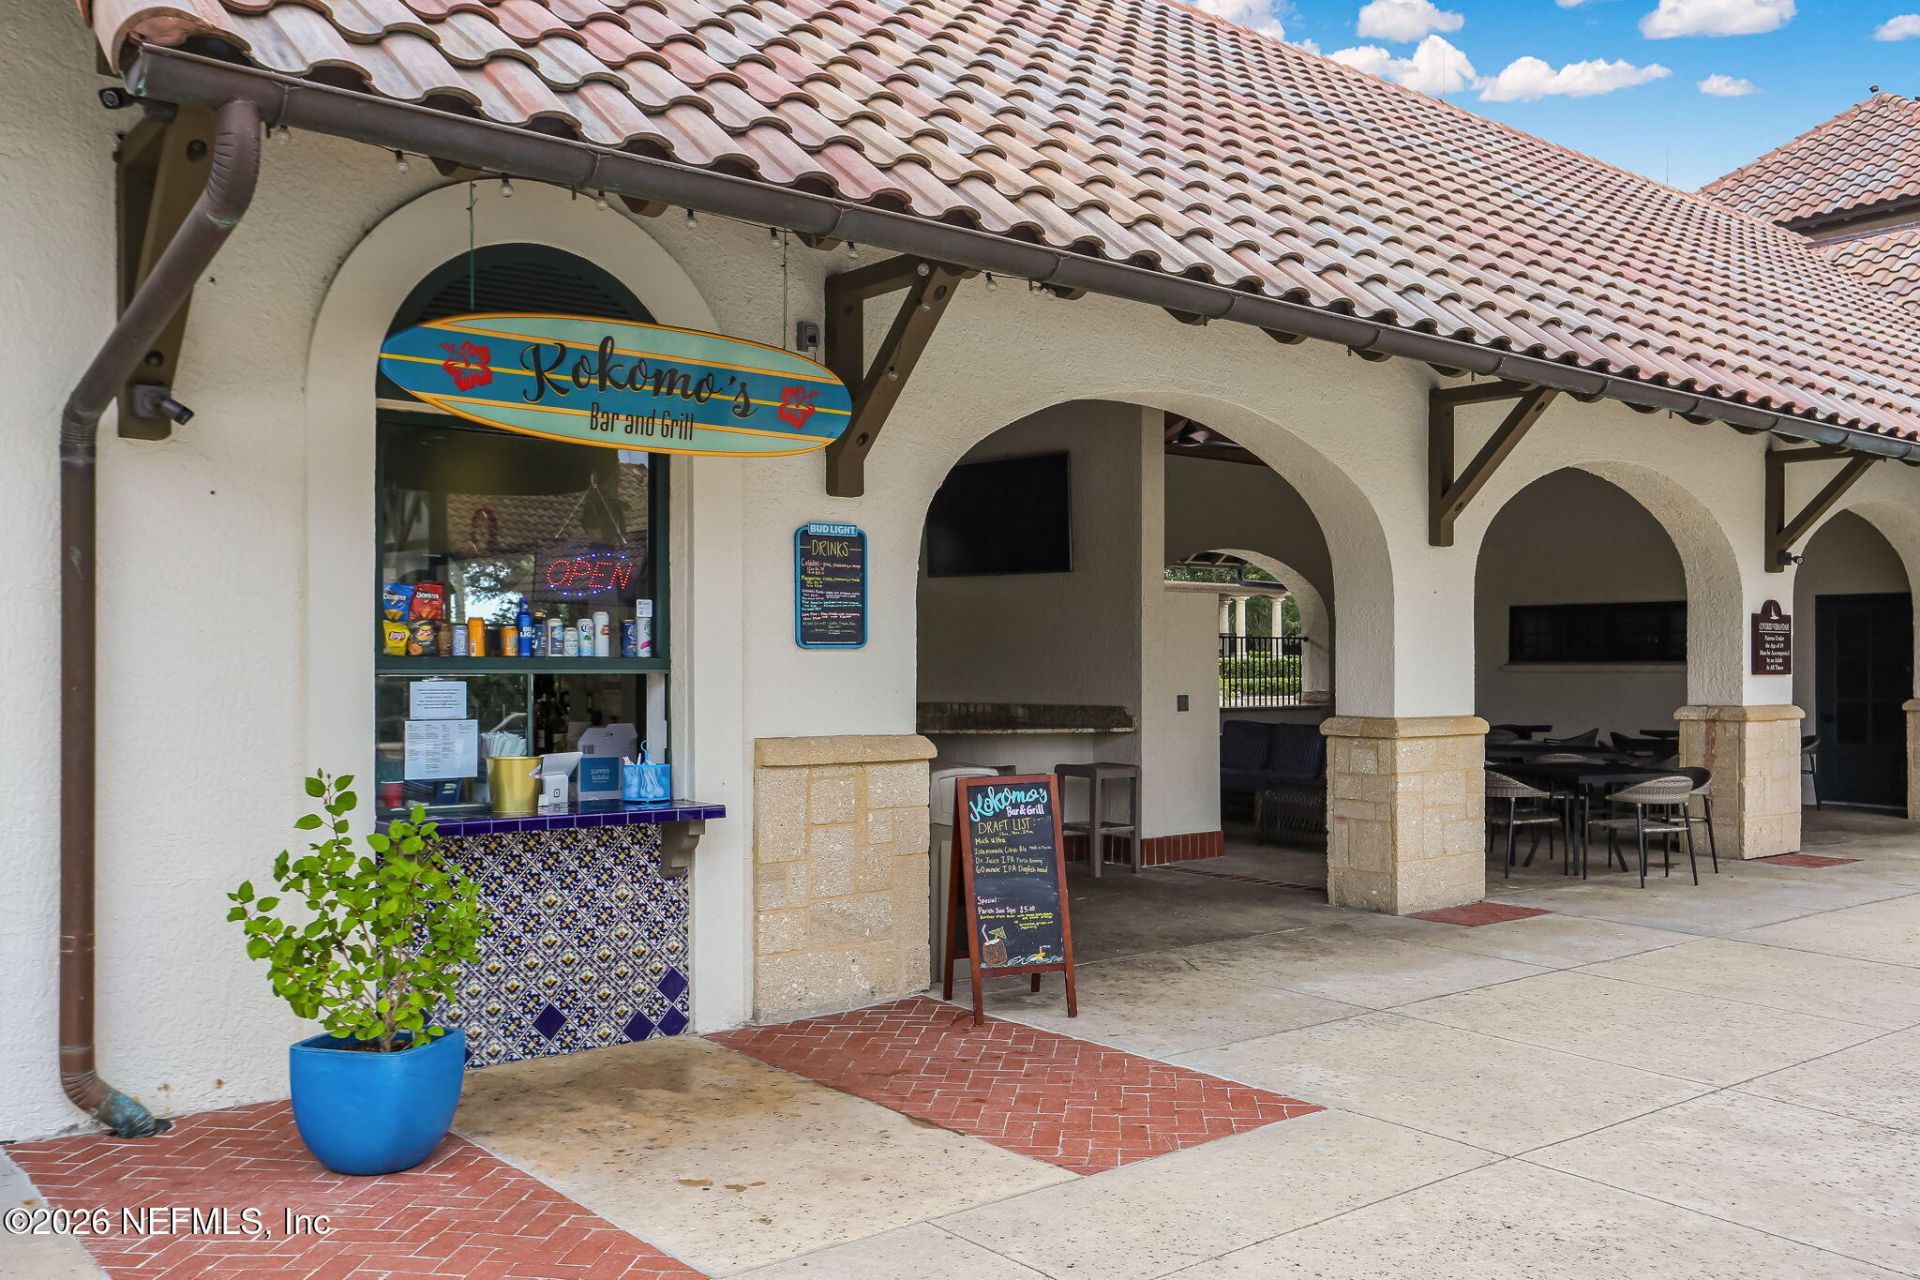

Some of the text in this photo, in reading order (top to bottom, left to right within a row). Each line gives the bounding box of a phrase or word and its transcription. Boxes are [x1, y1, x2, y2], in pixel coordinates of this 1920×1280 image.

[520, 335, 758, 417] Kokomo's
[590, 402, 694, 440] Bar and Grill
[810, 524, 856, 535] BUD LIGHT
[811, 539, 849, 558] DRINKS
[546, 560, 633, 590] OPEN
[969, 786, 1048, 823] Kokomo's
[978, 819, 1009, 835] DRAFT
